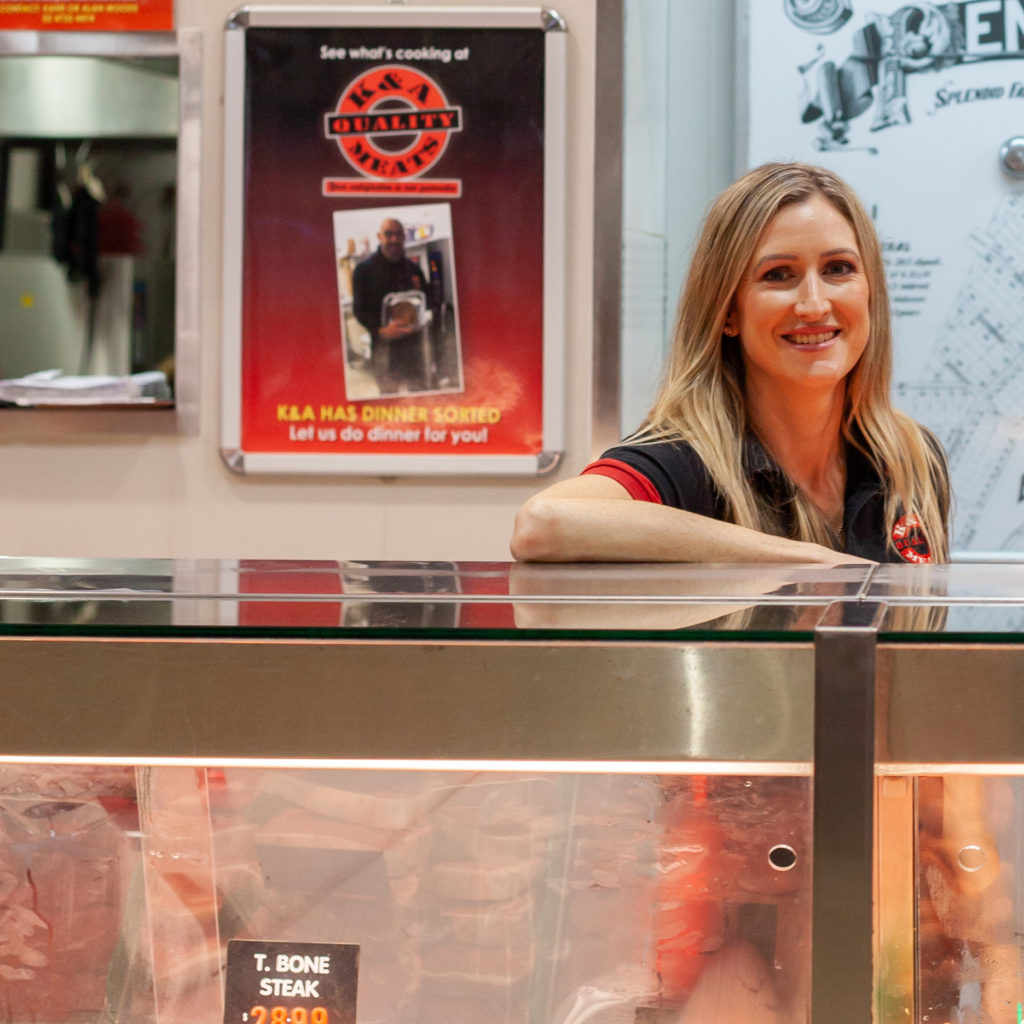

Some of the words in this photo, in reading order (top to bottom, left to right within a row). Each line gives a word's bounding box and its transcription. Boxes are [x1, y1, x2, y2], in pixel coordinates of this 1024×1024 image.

[320, 45, 347, 60] See
[349, 46, 393, 61] what's
[395, 46, 452, 63] cooking
[454, 47, 470, 61] at
[332, 111, 456, 133] QUALITY
[350, 136, 439, 175] MEATS
[277, 404, 316, 422] K&A
[320, 405, 358, 423] HAS
[362, 405, 429, 424] DINNER
[433, 405, 502, 424] SORTED
[289, 425, 315, 441] Let
[317, 427, 337, 442] us
[340, 426, 364, 442] do
[367, 426, 421, 442] dinner
[424, 426, 448, 442] for
[450, 427, 489, 446] you!
[253, 953, 271, 972] T.
[275, 954, 331, 974] BONE
[259, 978, 320, 998] STEAK
